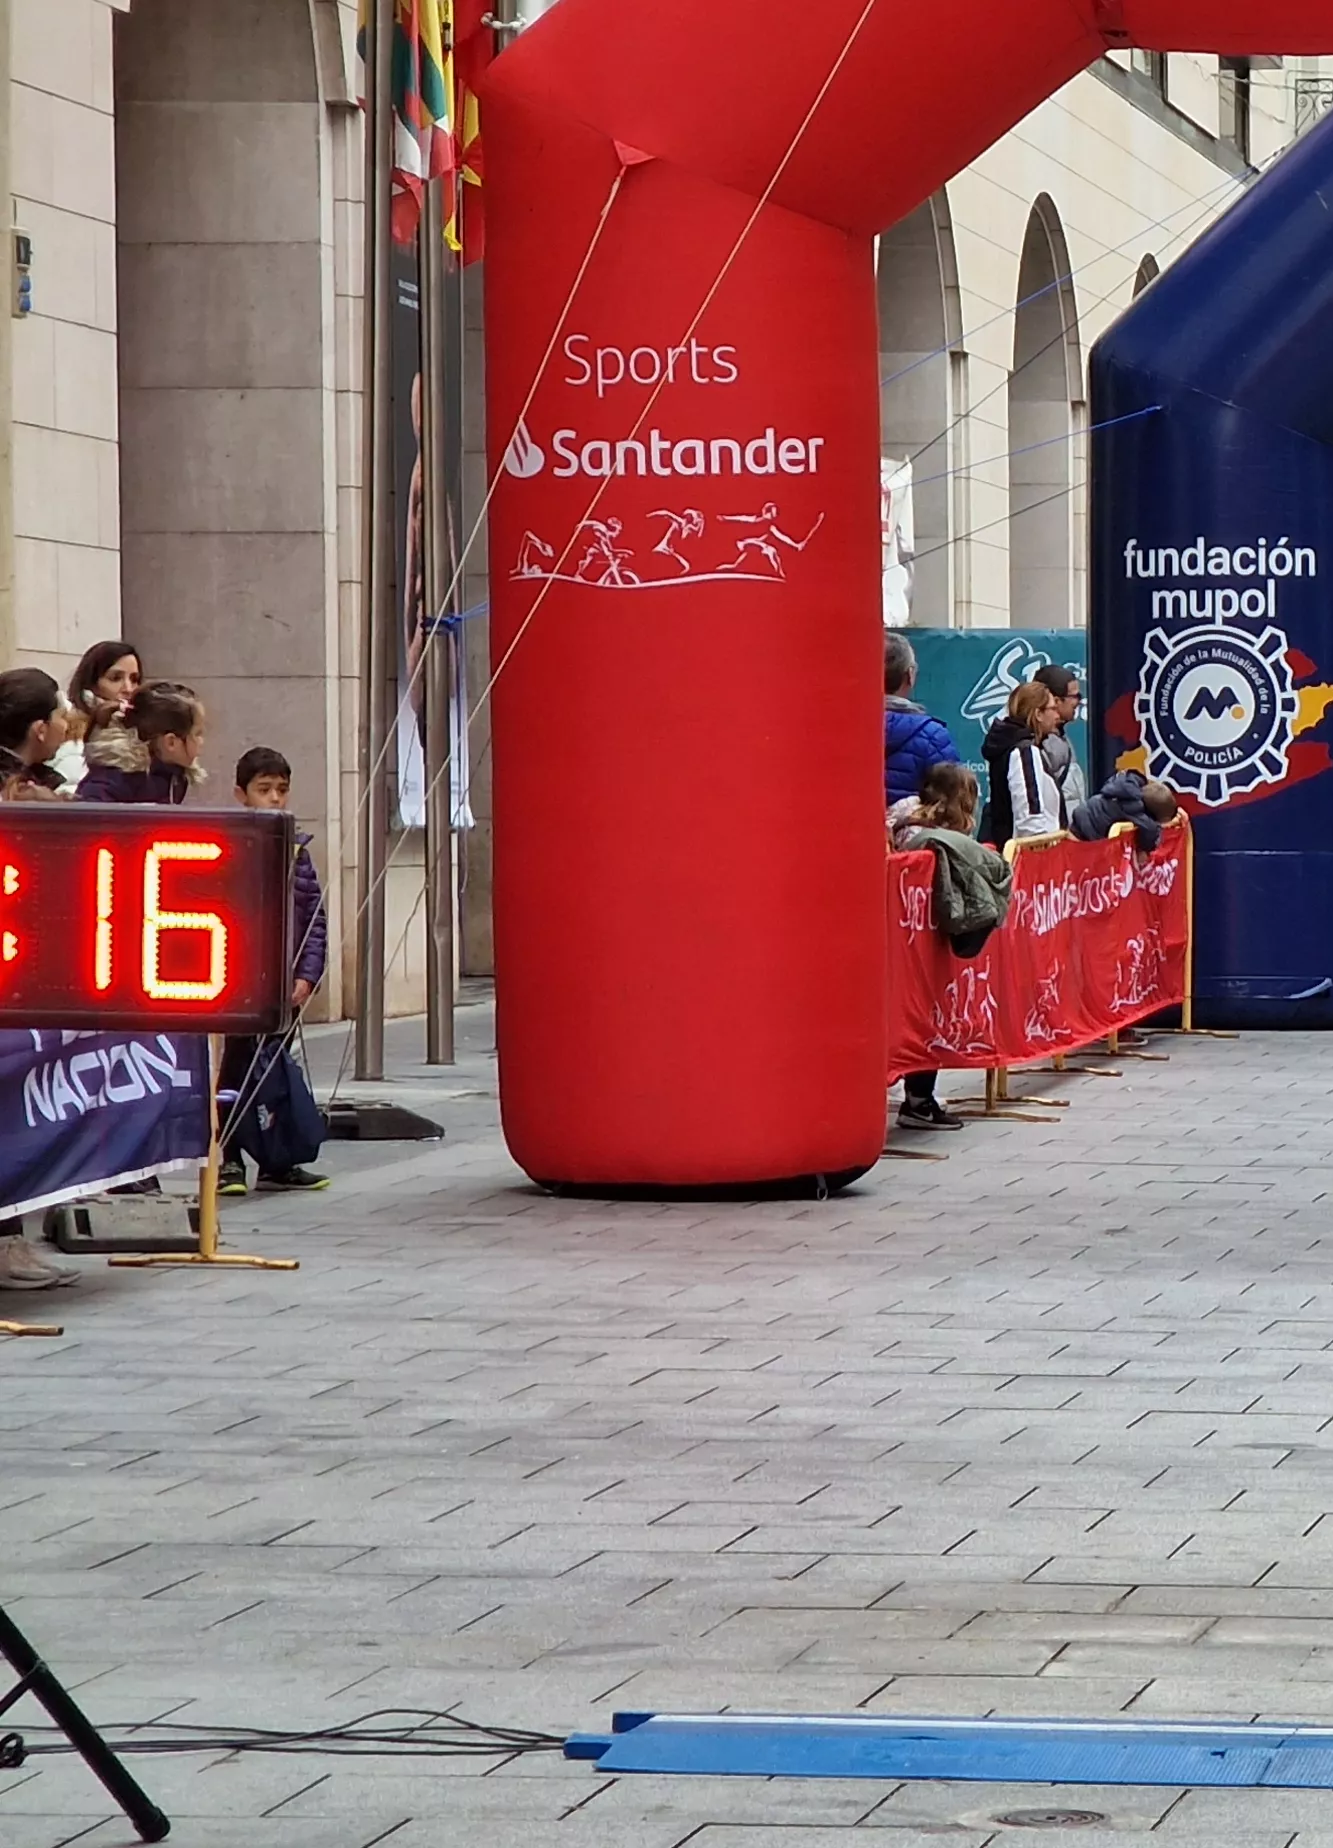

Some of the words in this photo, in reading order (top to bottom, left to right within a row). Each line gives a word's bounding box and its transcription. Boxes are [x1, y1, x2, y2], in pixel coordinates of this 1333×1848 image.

[563, 334, 738, 398] Sports
[552, 427, 825, 477] Santander
[1123, 536, 1317, 578] fundación
[1152, 578, 1276, 626] mupol
[1160, 663, 1184, 716] Fundación
[1182, 654, 1196, 666] de
[1198, 649, 1209, 659] la
[1211, 647, 1265, 686] Mutualidad
[1258, 686, 1269, 701] de
[1184, 746, 1244, 765] POLICÍA
